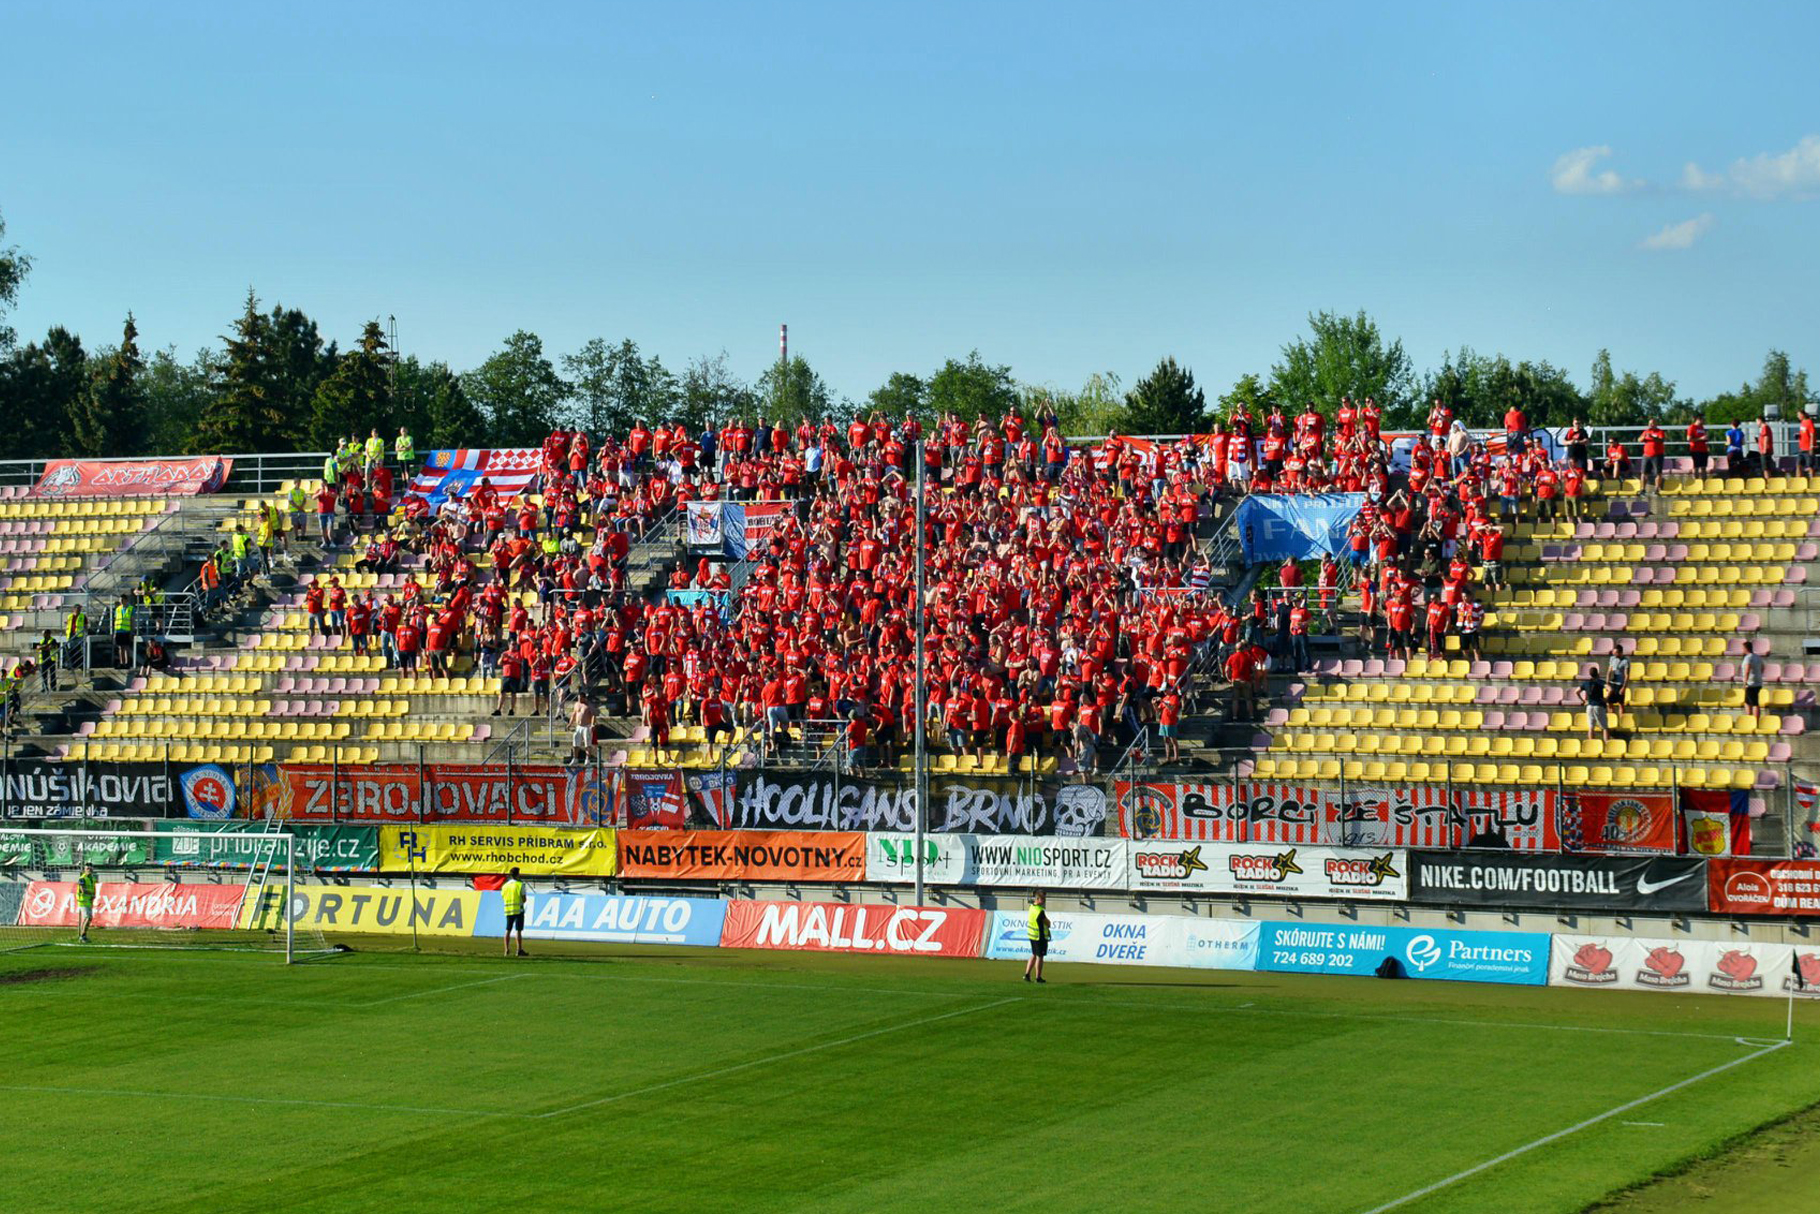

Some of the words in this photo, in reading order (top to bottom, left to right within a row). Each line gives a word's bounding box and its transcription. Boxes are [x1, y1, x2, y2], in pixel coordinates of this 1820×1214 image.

[931, 780, 1047, 833] BRNO
[77, 841, 137, 852] AKADEMIE
[449, 834, 465, 846] RH
[470, 835, 513, 847] SERVIS
[518, 834, 574, 848] PŘÍBRAM
[450, 853, 563, 864] www.rhobchod.cz
[971, 846, 1111, 868] WWW.NIOSPORT.CZ
[1138, 854, 1180, 867] ROCK
[1231, 857, 1274, 869] ROCK
[971, 867, 1012, 876] SPORTOVNÍ
[1064, 870, 1073, 878] PR
[1142, 866, 1186, 877] RADIO
[1237, 869, 1281, 880] RADIO
[1327, 861, 1371, 873] ROCK
[1332, 872, 1377, 884] RADIO
[1421, 864, 1620, 894] NIKE.COM/FOOTBALL
[253, 891, 464, 929] FORTUNA
[592, 898, 692, 932] AUTO
[756, 904, 947, 951] MALL.CZ
[1103, 923, 1146, 939] OKNA
[1274, 928, 1334, 949] SKÓRUJTE
[1336, 932, 1346, 949] S
[1349, 930, 1386, 950] NÁMI!
[1096, 942, 1147, 960] DVEŘE
[1448, 939, 1532, 962] Partners
[1273, 951, 1297, 965] 724
[1300, 952, 1324, 966] 689
[1328, 953, 1353, 967] 202
